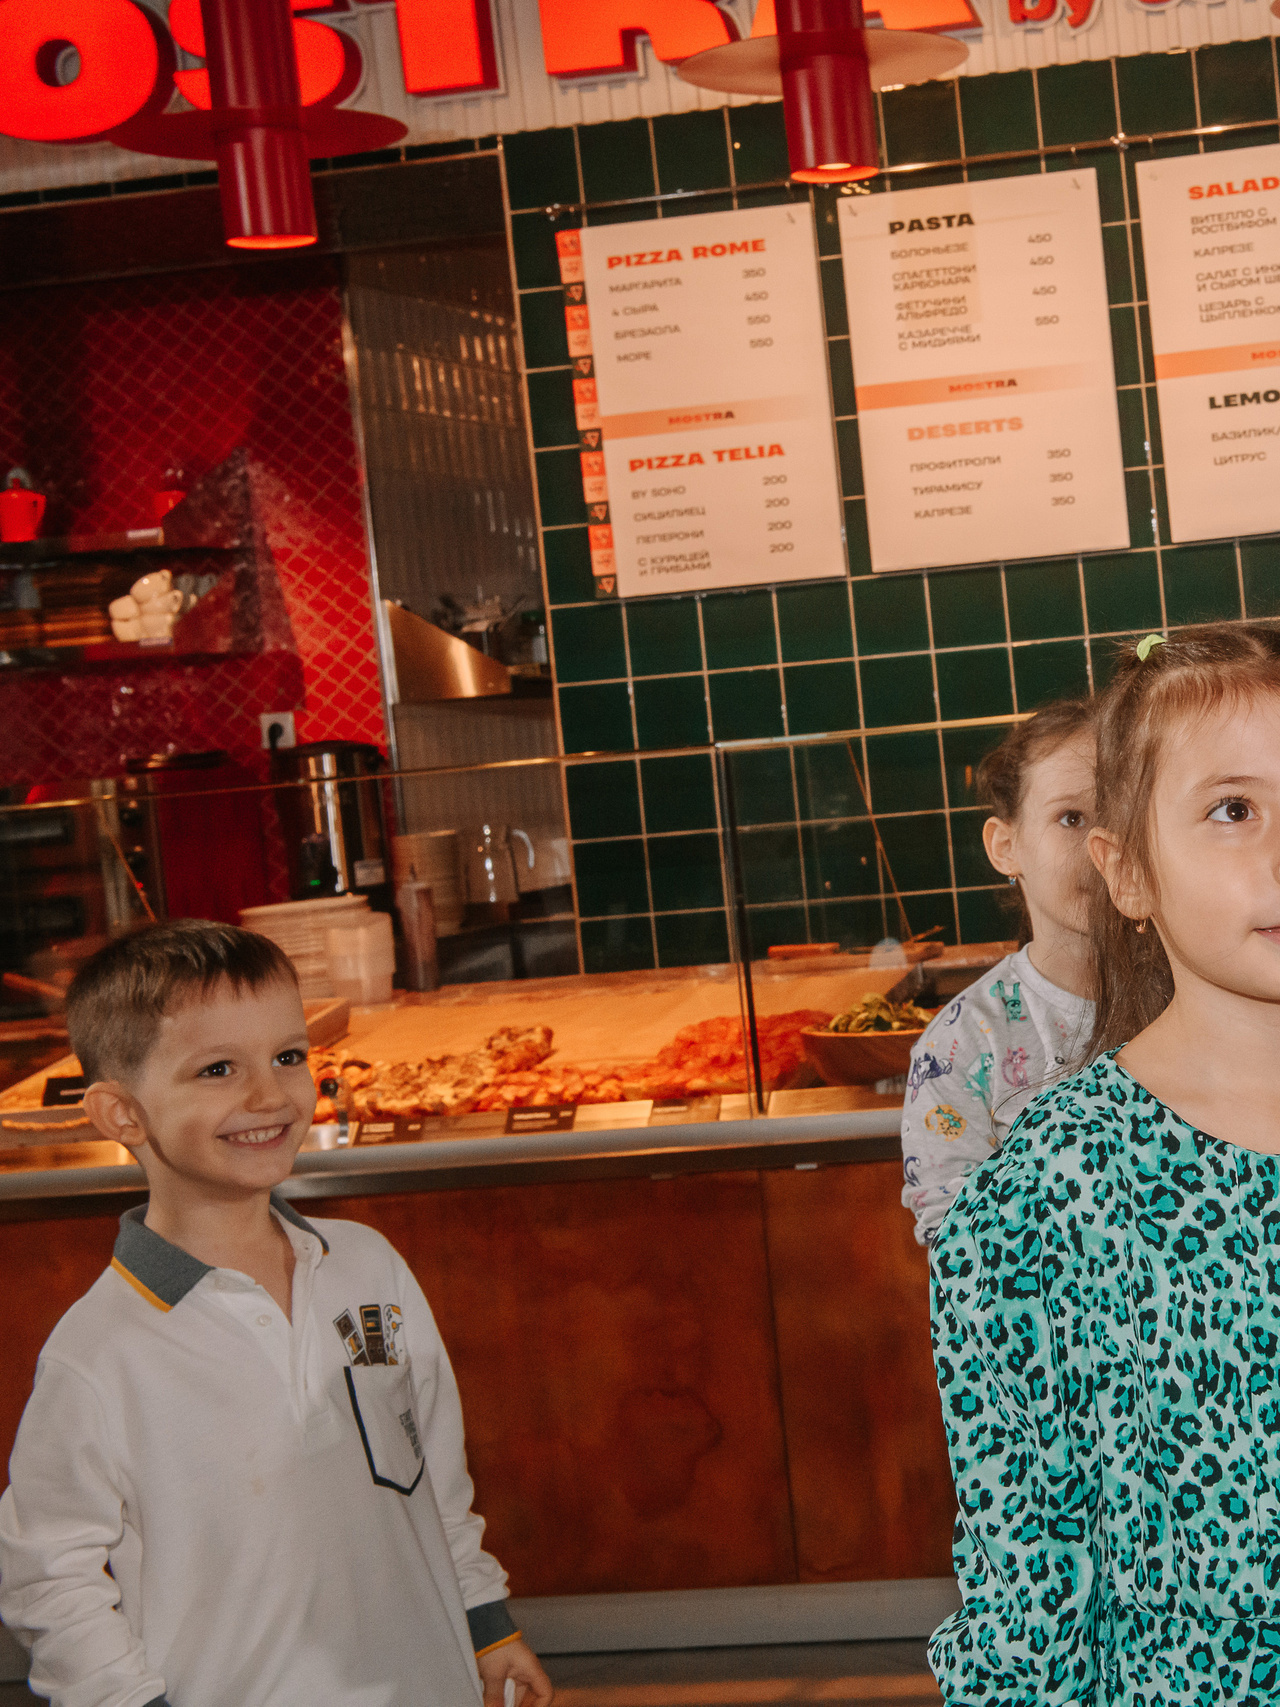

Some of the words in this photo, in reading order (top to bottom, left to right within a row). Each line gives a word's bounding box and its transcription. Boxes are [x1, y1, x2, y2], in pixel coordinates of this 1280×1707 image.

[889, 212, 975, 235] PASTA
[1190, 208, 1255, 225] ВИТЕЛЛО
[1257, 207, 1268, 217] С
[1191, 216, 1277, 235] РОСТБИФОМ
[1028, 233, 1052, 244] 450
[607, 249, 683, 270] PIZZA
[692, 238, 767, 260] ROME
[891, 242, 969, 260] БОЛОНЬЕЗЕ
[1193, 242, 1254, 258] КАПРЕЗЕ
[1029, 255, 1054, 266] 450
[892, 264, 977, 282] СПАГЕТТОНИ
[1196, 268, 1237, 282] САЛАТ
[1242, 266, 1251, 277] С
[608, 277, 683, 294] МАРГАРИТА
[893, 275, 971, 292] КАРБОНАРА
[1032, 285, 1057, 296] 450
[1210, 276, 1261, 291] СЫРОМ
[744, 290, 769, 302] 450
[895, 295, 966, 311] ФЕТУЧИНИ
[622, 303, 659, 317] СЫРА
[1198, 299, 1252, 314] ЦЕЗАРЬ
[1255, 296, 1265, 306] С
[747, 314, 771, 326] 550
[896, 305, 968, 322] АЛЬФРЕДО
[1035, 315, 1059, 326] 550
[614, 324, 681, 341] БРЕЗАОЛА
[898, 324, 972, 340] КАЗАРЕЧЧЕ
[749, 337, 774, 350] 550
[898, 340, 908, 351] С
[912, 334, 981, 350] МИДИЯМИ
[616, 350, 651, 364] МОРЕ
[949, 378, 1018, 393] MOSTRA
[667, 410, 735, 426] MOSTRA
[907, 416, 1024, 441] DESERTS
[629, 452, 705, 473] PIZZA
[712, 443, 786, 464] TELIA
[1047, 448, 1071, 459] 350
[1213, 451, 1267, 466] ЦИТРУС
[910, 455, 1001, 473] ПРОФИТРОЛИ
[762, 475, 787, 486] 200
[1049, 472, 1073, 483] 350
[631, 490, 647, 500] BY
[651, 485, 686, 498] SOHO
[912, 481, 983, 497] ТИРАМИСУ
[765, 497, 790, 509] 200
[1051, 496, 1075, 507] 350
[633, 506, 706, 523] СИЦИЛИЕЦ
[914, 505, 973, 519] КАПРЕЗЕ
[767, 520, 792, 531] 200
[636, 530, 705, 545] ПЕПЕРОНИ
[769, 543, 794, 554] 200
[637, 556, 647, 567] С
[650, 561, 711, 575] ГРИБАМИ
